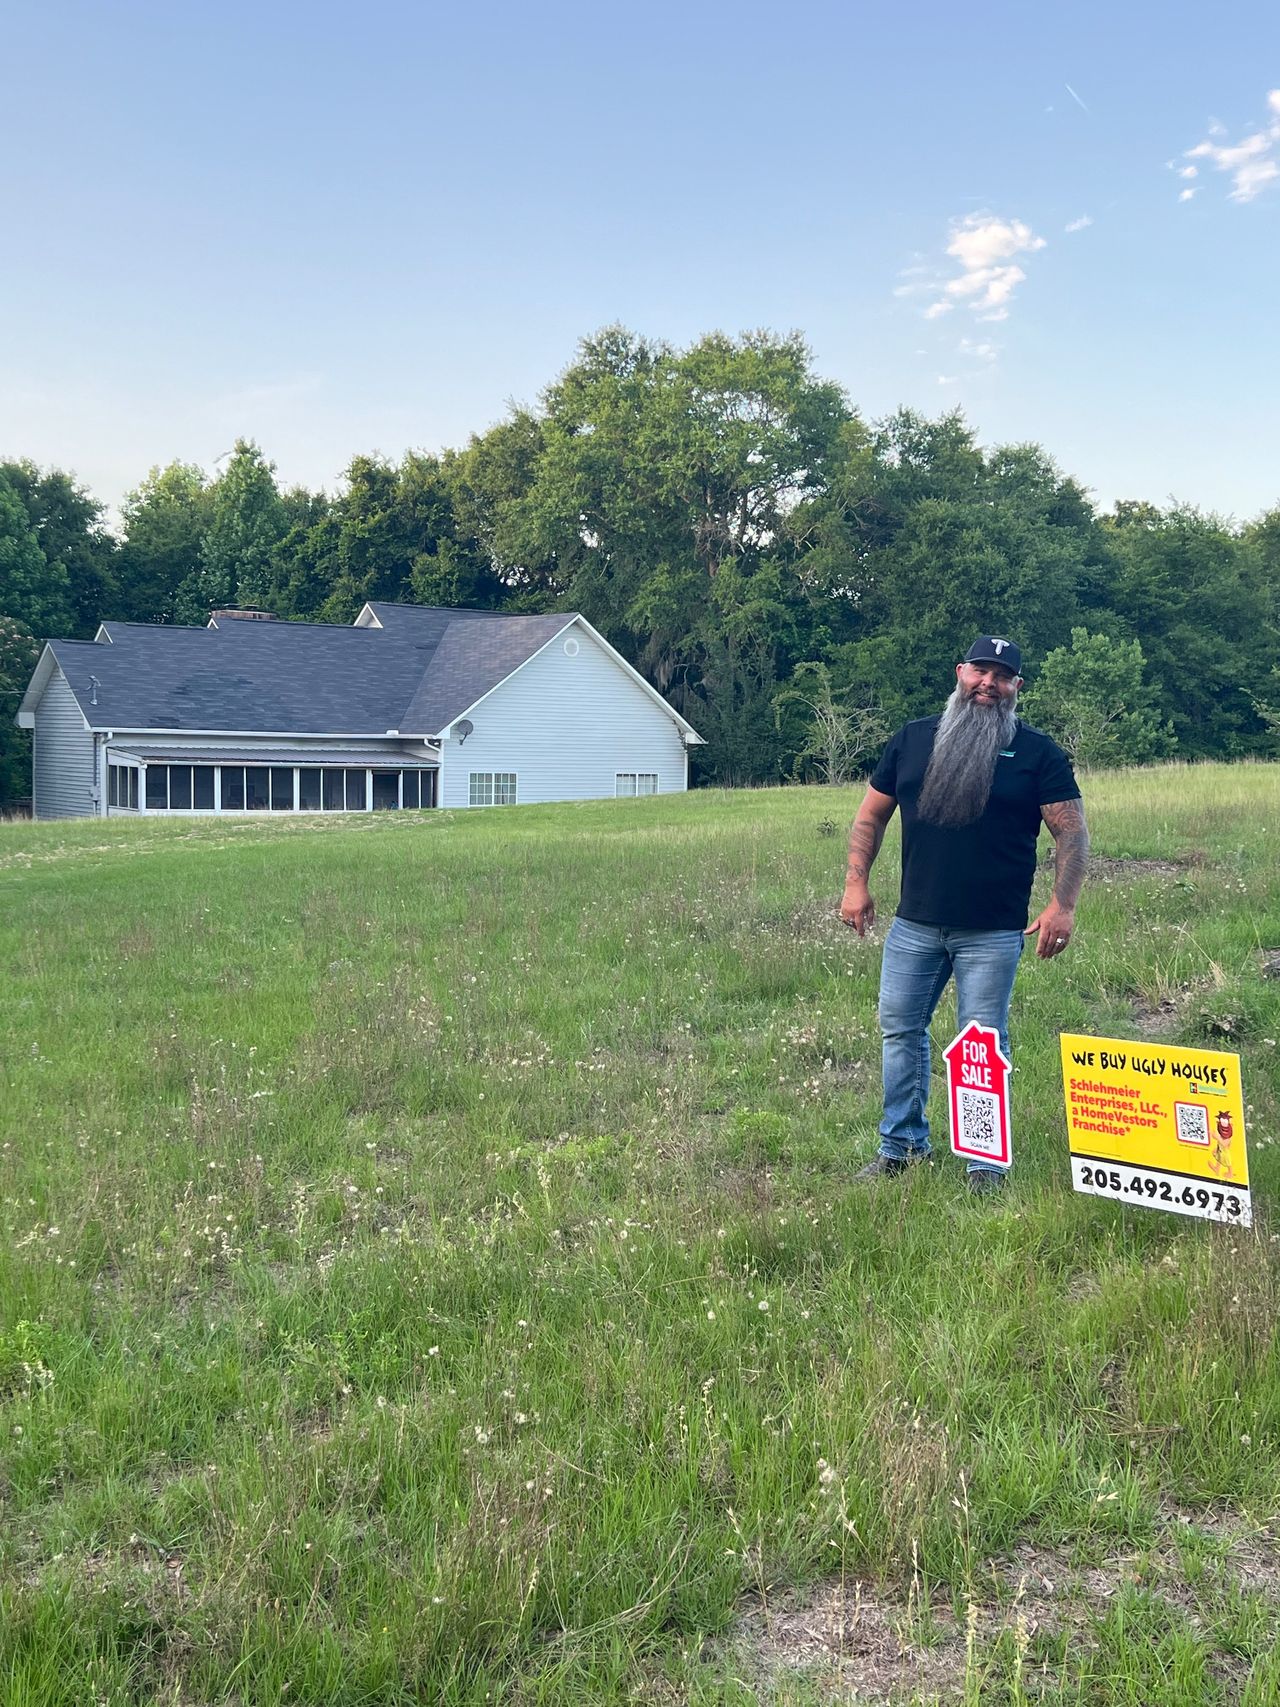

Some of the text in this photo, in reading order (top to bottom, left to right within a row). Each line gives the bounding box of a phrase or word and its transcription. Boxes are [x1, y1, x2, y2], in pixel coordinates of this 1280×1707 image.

[991, 639, 1010, 655] T
[962, 1040, 988, 1065] FOR
[962, 1064, 992, 1088] SALE
[1072, 1051, 1228, 1086] WE BUY UGLY HOUSES
[1070, 1079, 1141, 1099] Schlehmeier
[1071, 1092, 1168, 1118] Enterprises, LLC.,
[1072, 1104, 1158, 1128] a HomeVestors
[1081, 1166, 1241, 1216] 205.492.6973
